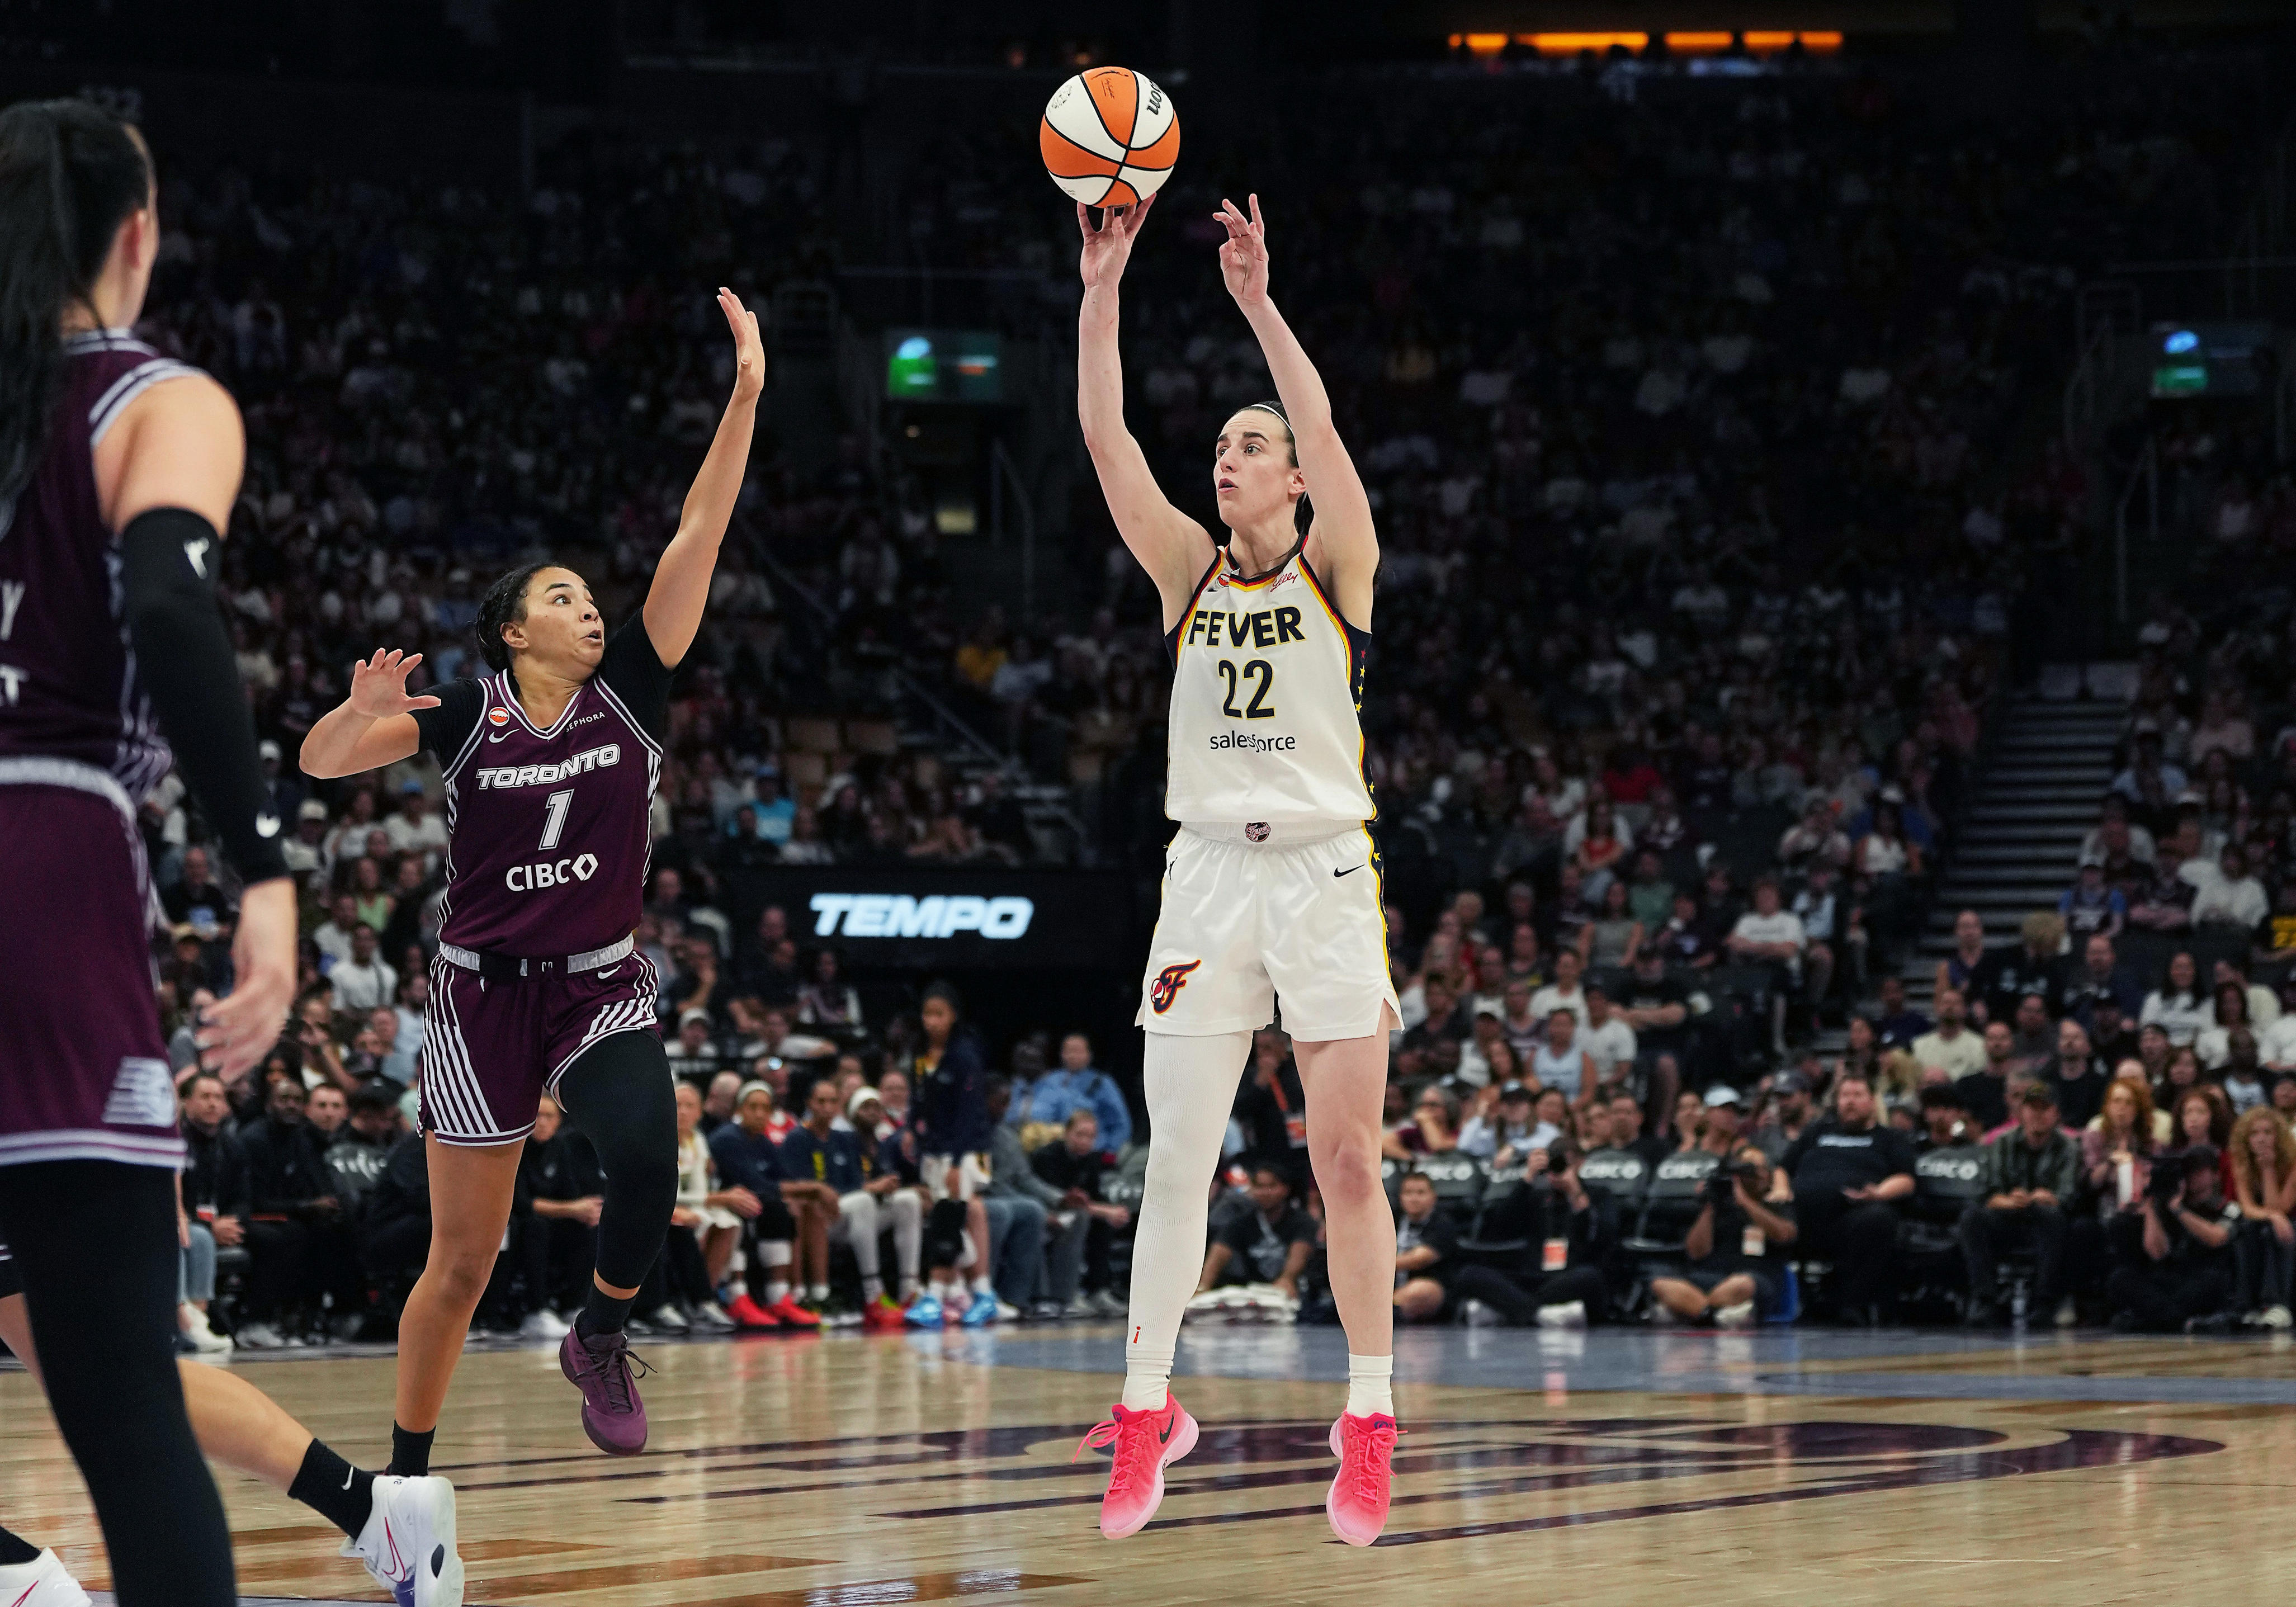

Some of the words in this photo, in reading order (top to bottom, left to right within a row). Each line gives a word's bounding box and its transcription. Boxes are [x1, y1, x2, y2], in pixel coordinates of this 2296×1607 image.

[1270, 572, 1298, 592] Lilly
[1188, 606, 1307, 650] FEVER
[1218, 658, 1275, 720] 22
[1210, 730, 1296, 753] salesforce
[476, 744, 621, 790] TORONTO
[538, 788, 575, 850] 1
[506, 859, 571, 891] CIBC
[810, 893, 1034, 939] TEMPO
